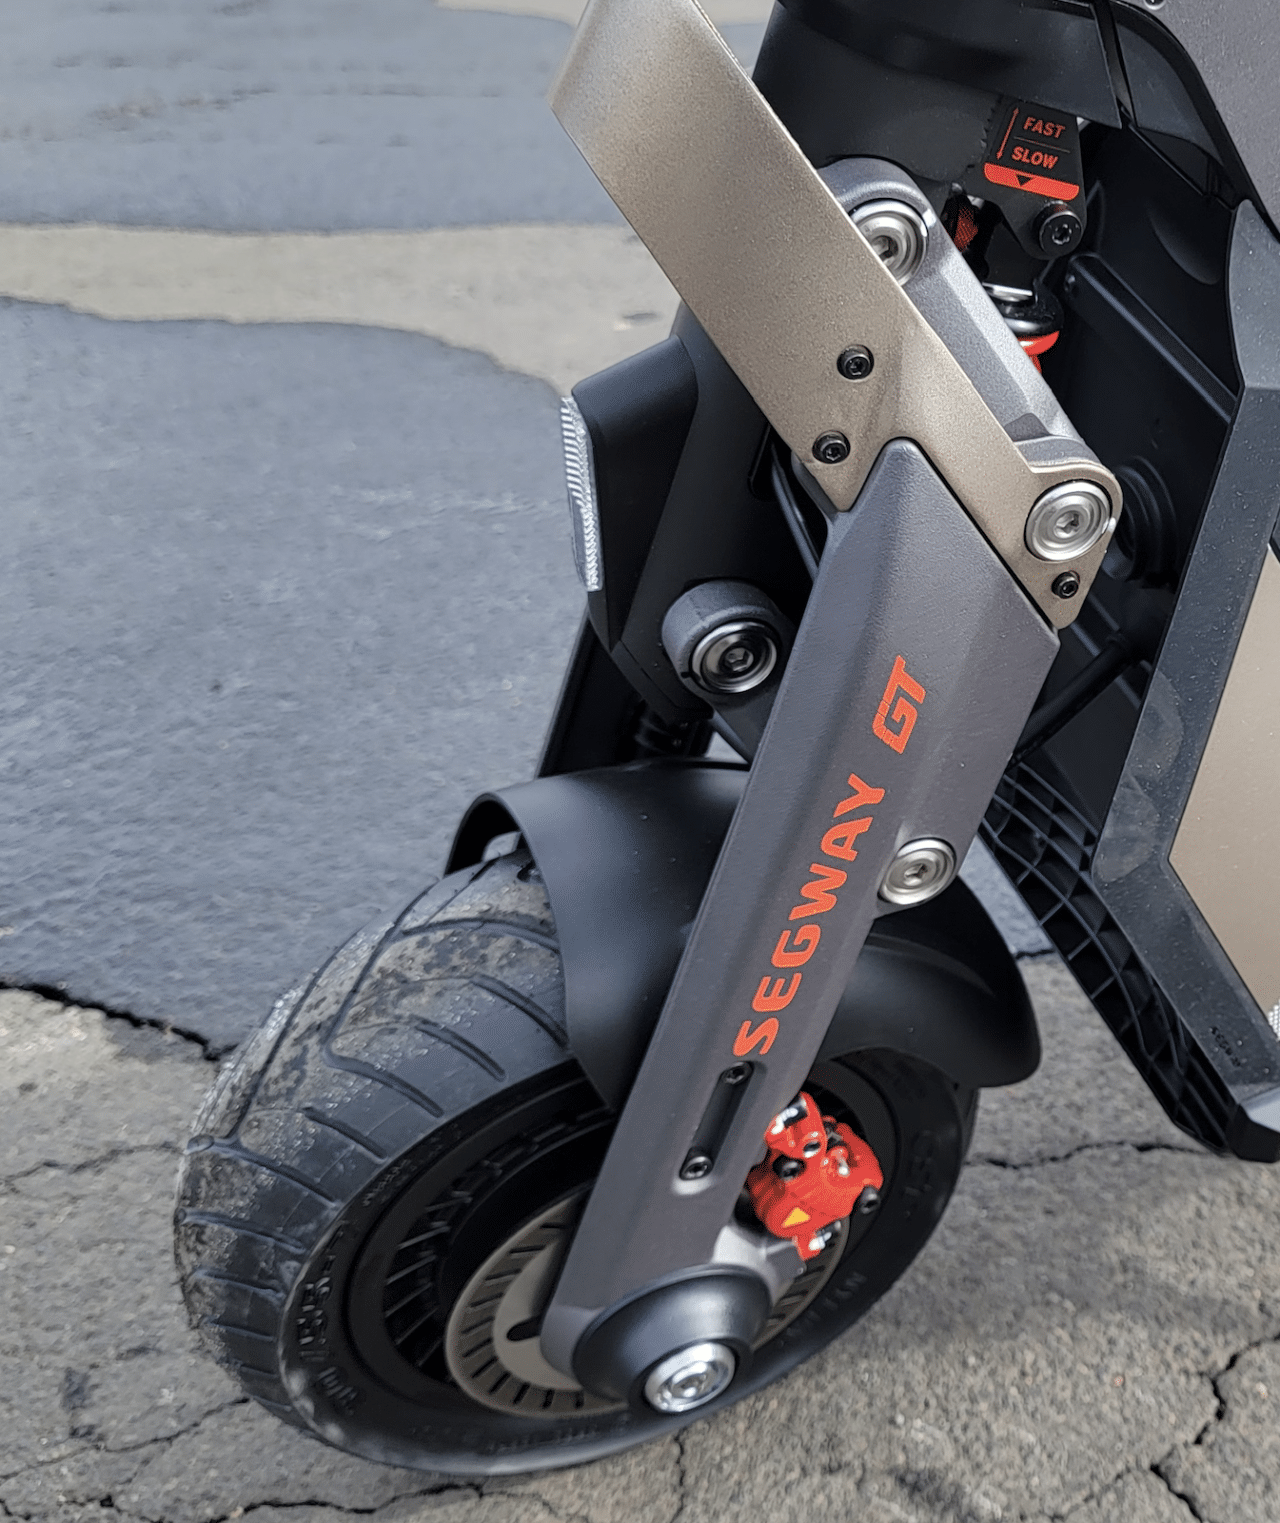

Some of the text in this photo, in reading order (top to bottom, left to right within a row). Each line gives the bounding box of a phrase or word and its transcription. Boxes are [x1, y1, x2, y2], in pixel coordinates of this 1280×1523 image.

[1023, 116, 1066, 139] FAST
[1011, 146, 1059, 170] SLOW
[732, 654, 927, 1058] SEGWAY GT
